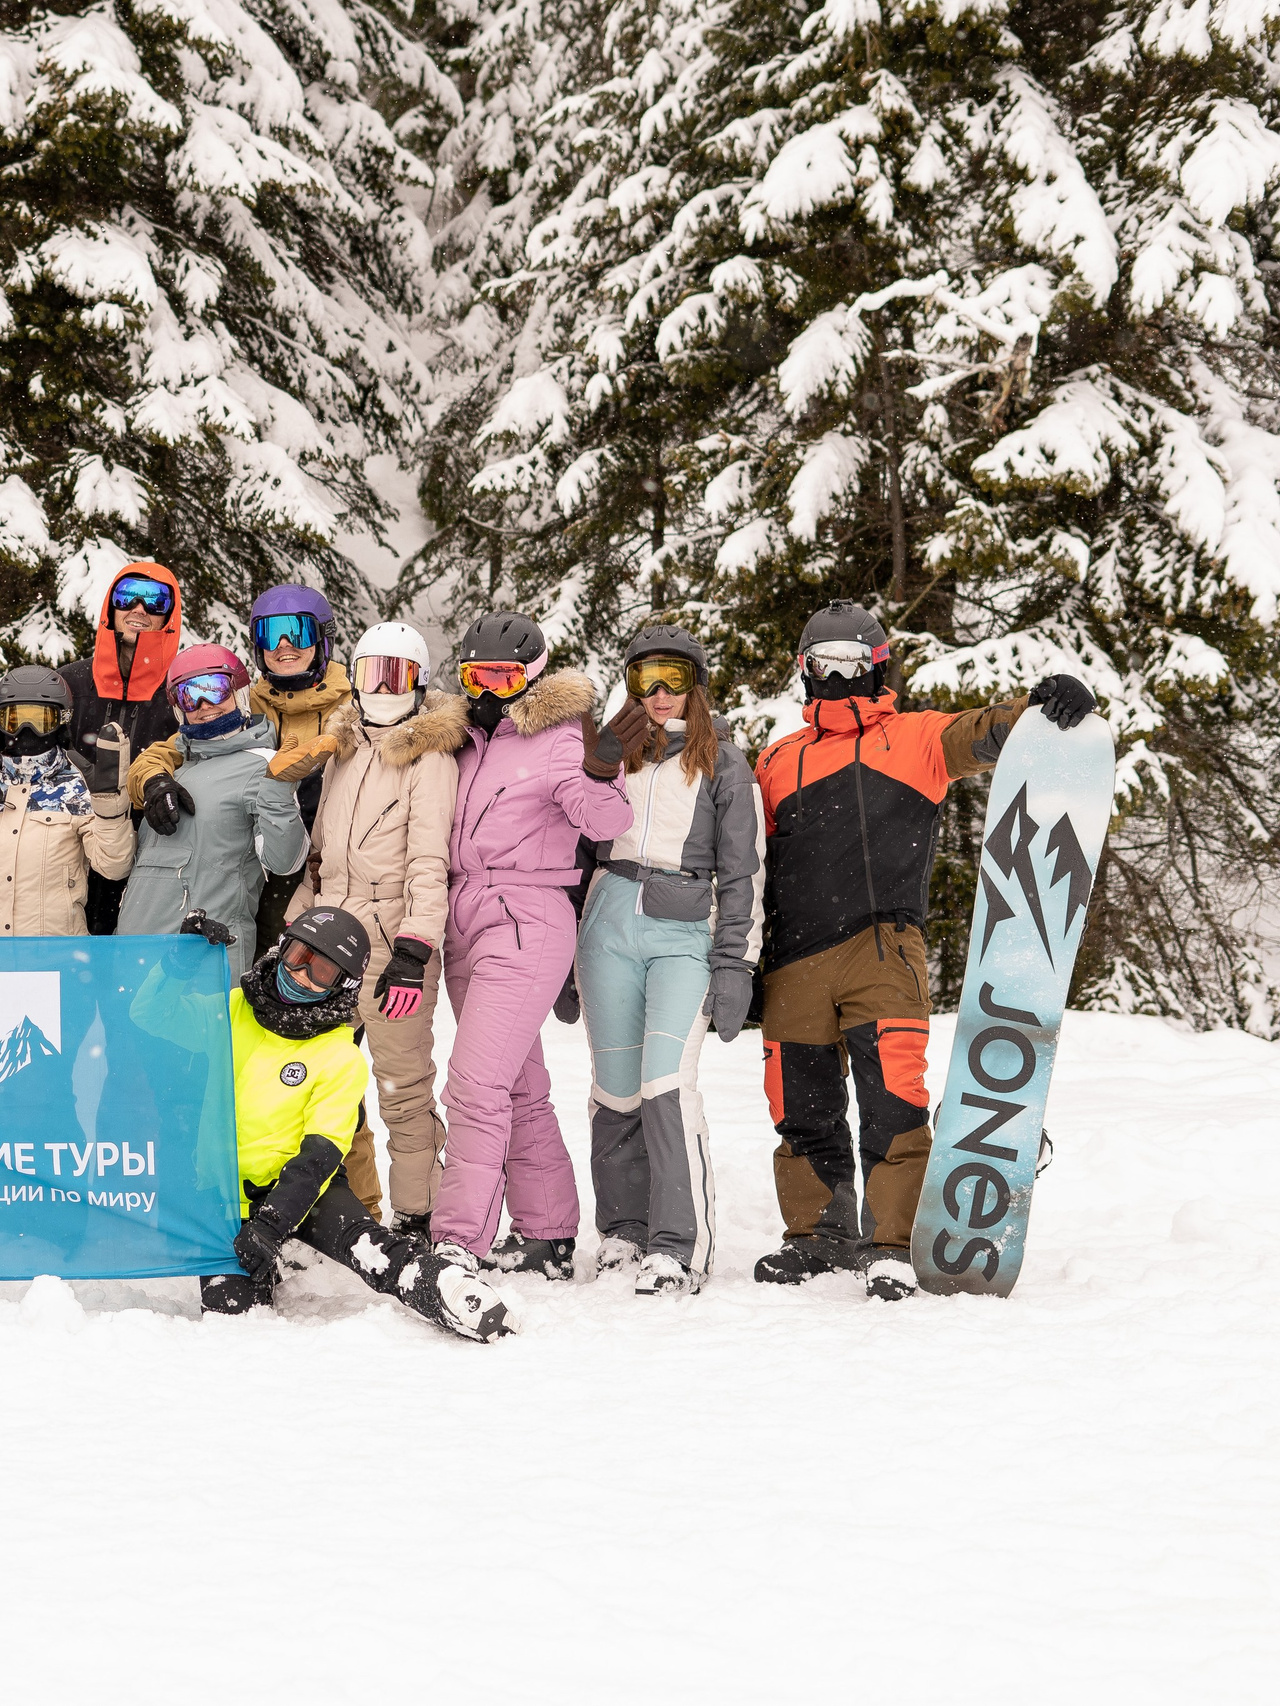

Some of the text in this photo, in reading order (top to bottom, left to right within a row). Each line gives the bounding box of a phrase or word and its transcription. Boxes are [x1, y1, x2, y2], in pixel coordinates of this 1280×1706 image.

[44, 1141, 156, 1177] ТУРЫ
[50, 1187, 82, 1203] по
[88, 1190, 156, 1213] миру
